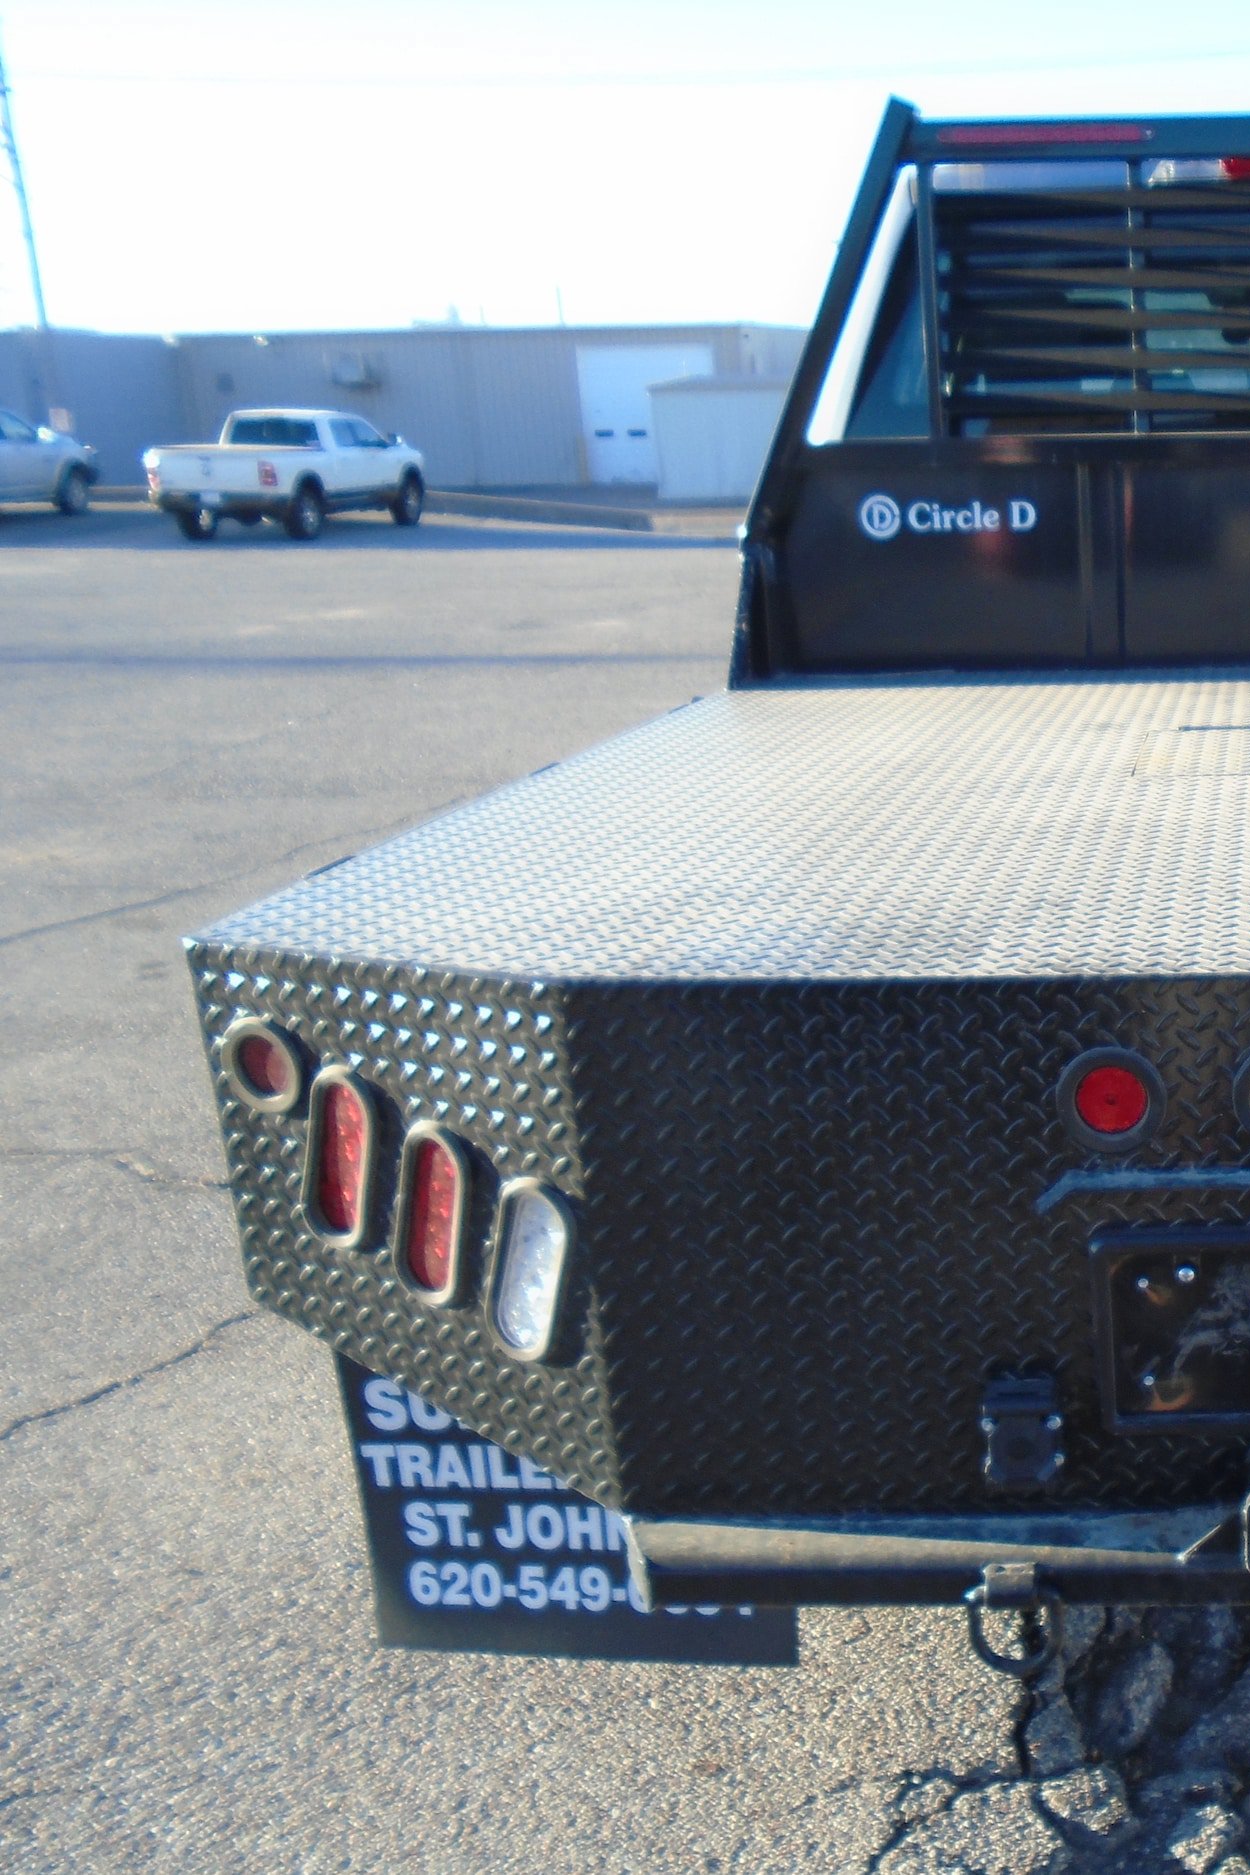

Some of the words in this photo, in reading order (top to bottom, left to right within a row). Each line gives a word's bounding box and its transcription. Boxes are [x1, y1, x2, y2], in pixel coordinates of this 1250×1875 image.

[908, 501, 1000, 531] Circle
[1011, 500, 1037, 530] D
[361, 1444, 568, 1490] TRAILE
[404, 1502, 481, 1547] ST.
